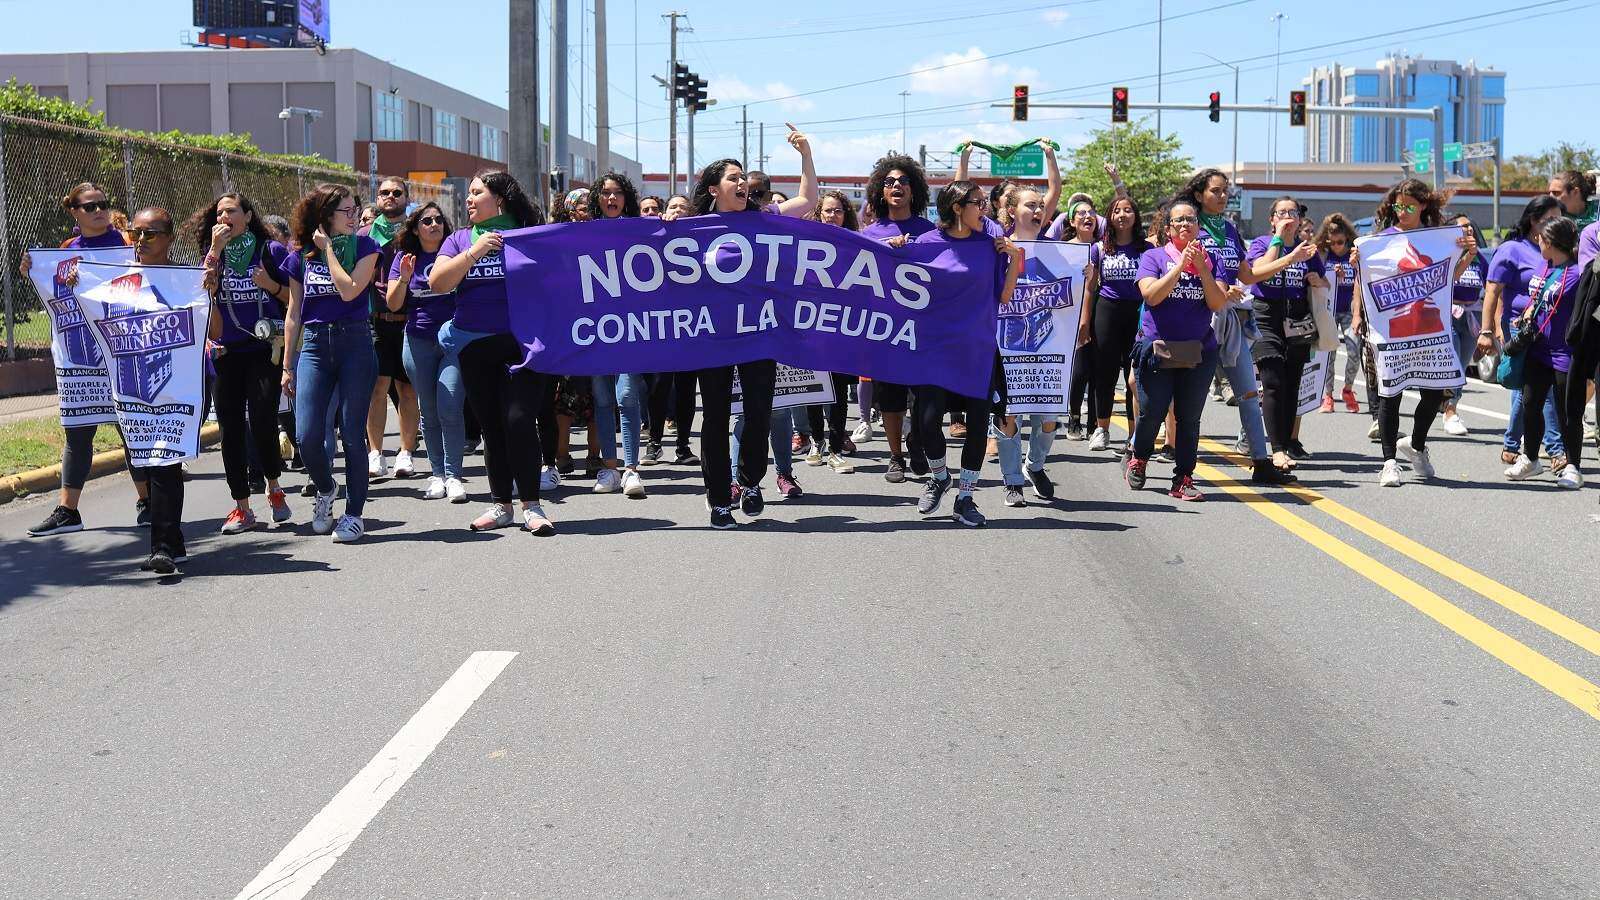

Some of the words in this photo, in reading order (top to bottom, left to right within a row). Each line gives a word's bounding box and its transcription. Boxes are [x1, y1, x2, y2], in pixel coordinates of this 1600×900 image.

[467, 268, 481, 277] LA
[484, 267, 505, 276] DEU
[577, 232, 932, 310] NOSOTRAS
[1378, 265, 1444, 294] EMBARGO
[1012, 282, 1062, 301] BARGO
[998, 295, 1066, 315] EMINISTA
[571, 305, 716, 346] CONTRA
[736, 298, 778, 334] LA
[793, 300, 918, 351] DEUDA
[1386, 342, 1409, 351] AVISO
[1009, 355, 1036, 363] BANCO
[1385, 355, 1420, 368] PERSONAS
[1005, 368, 1037, 376] UITARLE
[788, 386, 808, 394] BANK
[1036, 382, 1042, 390] Y
[1043, 382, 1052, 390] EL
[75, 407, 103, 416] BANCO
[125, 403, 153, 413] BANCO
[154, 404, 190, 414] POPULAR
[157, 426, 183, 436] CASAS
